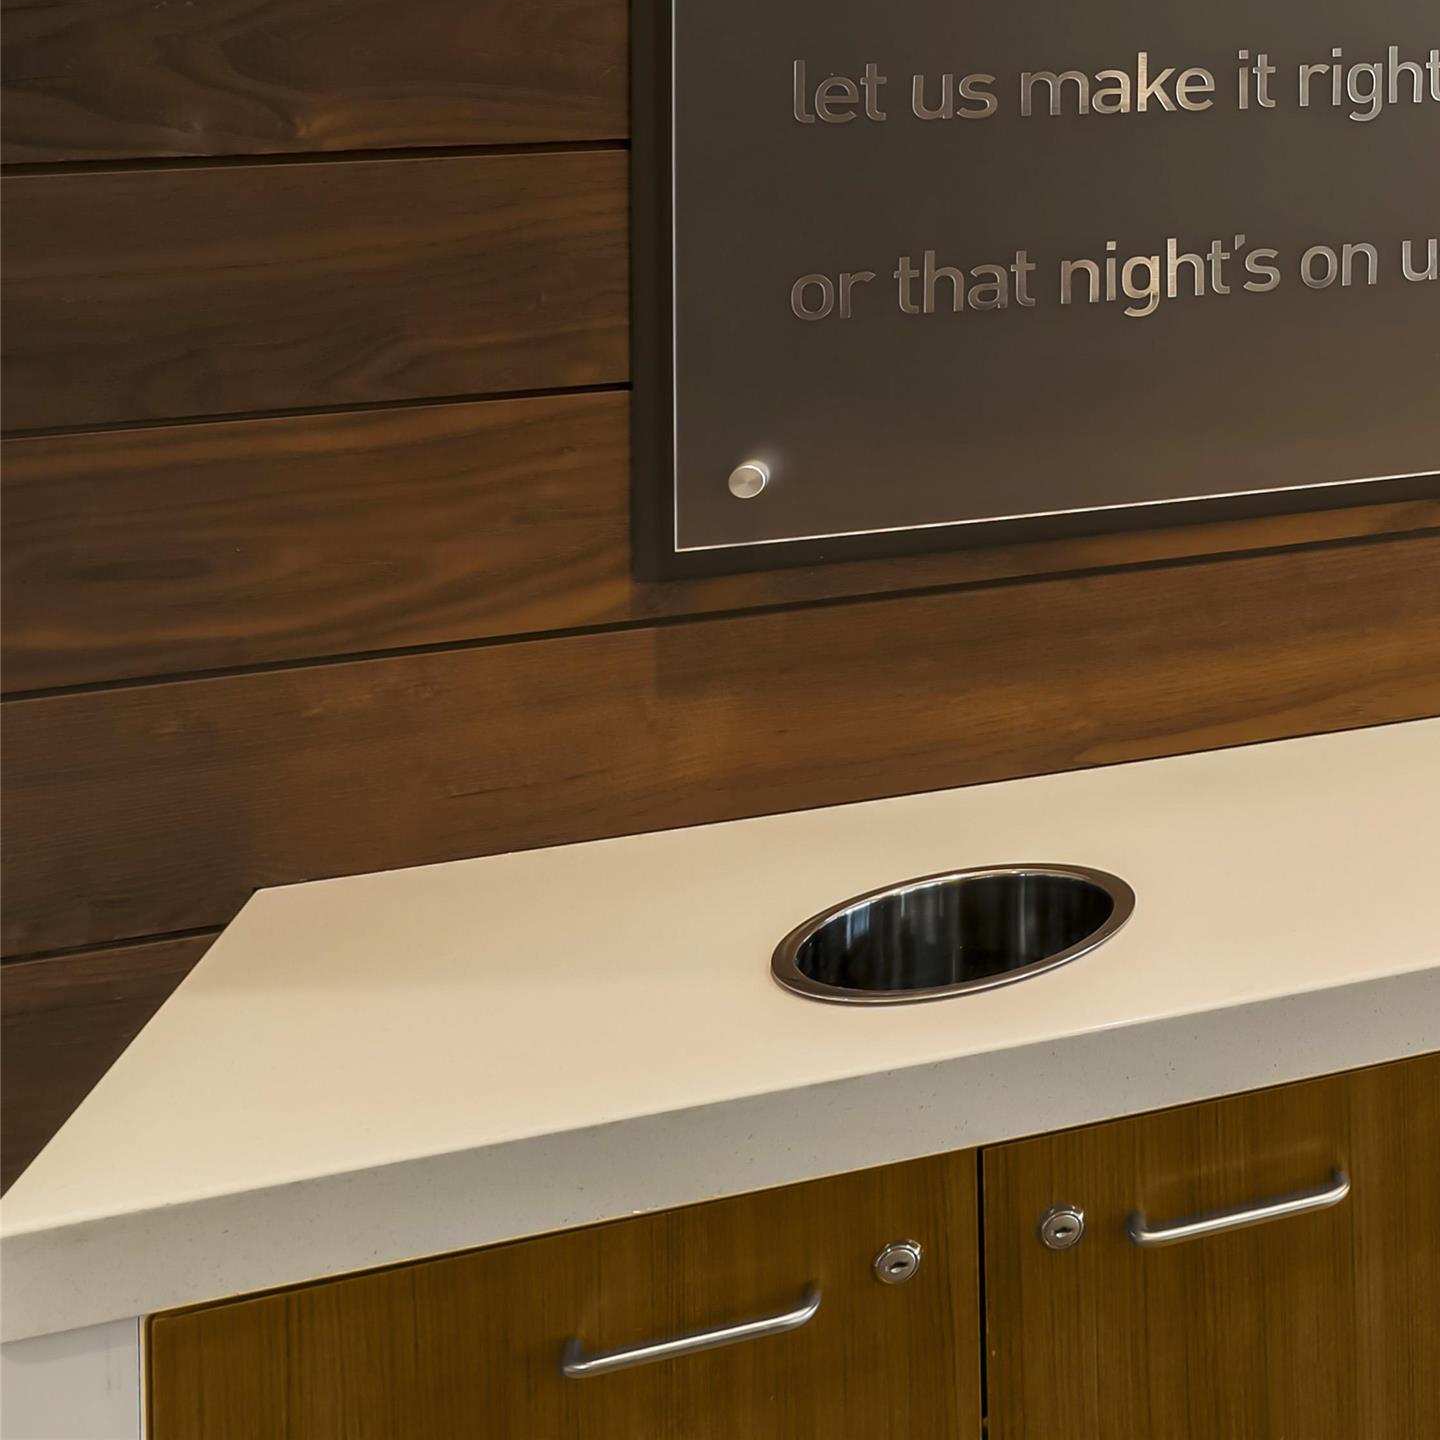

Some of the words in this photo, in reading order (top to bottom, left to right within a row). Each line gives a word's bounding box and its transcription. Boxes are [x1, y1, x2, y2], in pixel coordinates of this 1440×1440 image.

[793, 59, 887, 125] let
[911, 68, 999, 121] us
[1020, 51, 1216, 117] make
[1239, 49, 1277, 110] it
[790, 270, 876, 320] or
[893, 250, 1036, 316] that
[1060, 233, 1281, 318] night's
[1300, 242, 1378, 290] on
